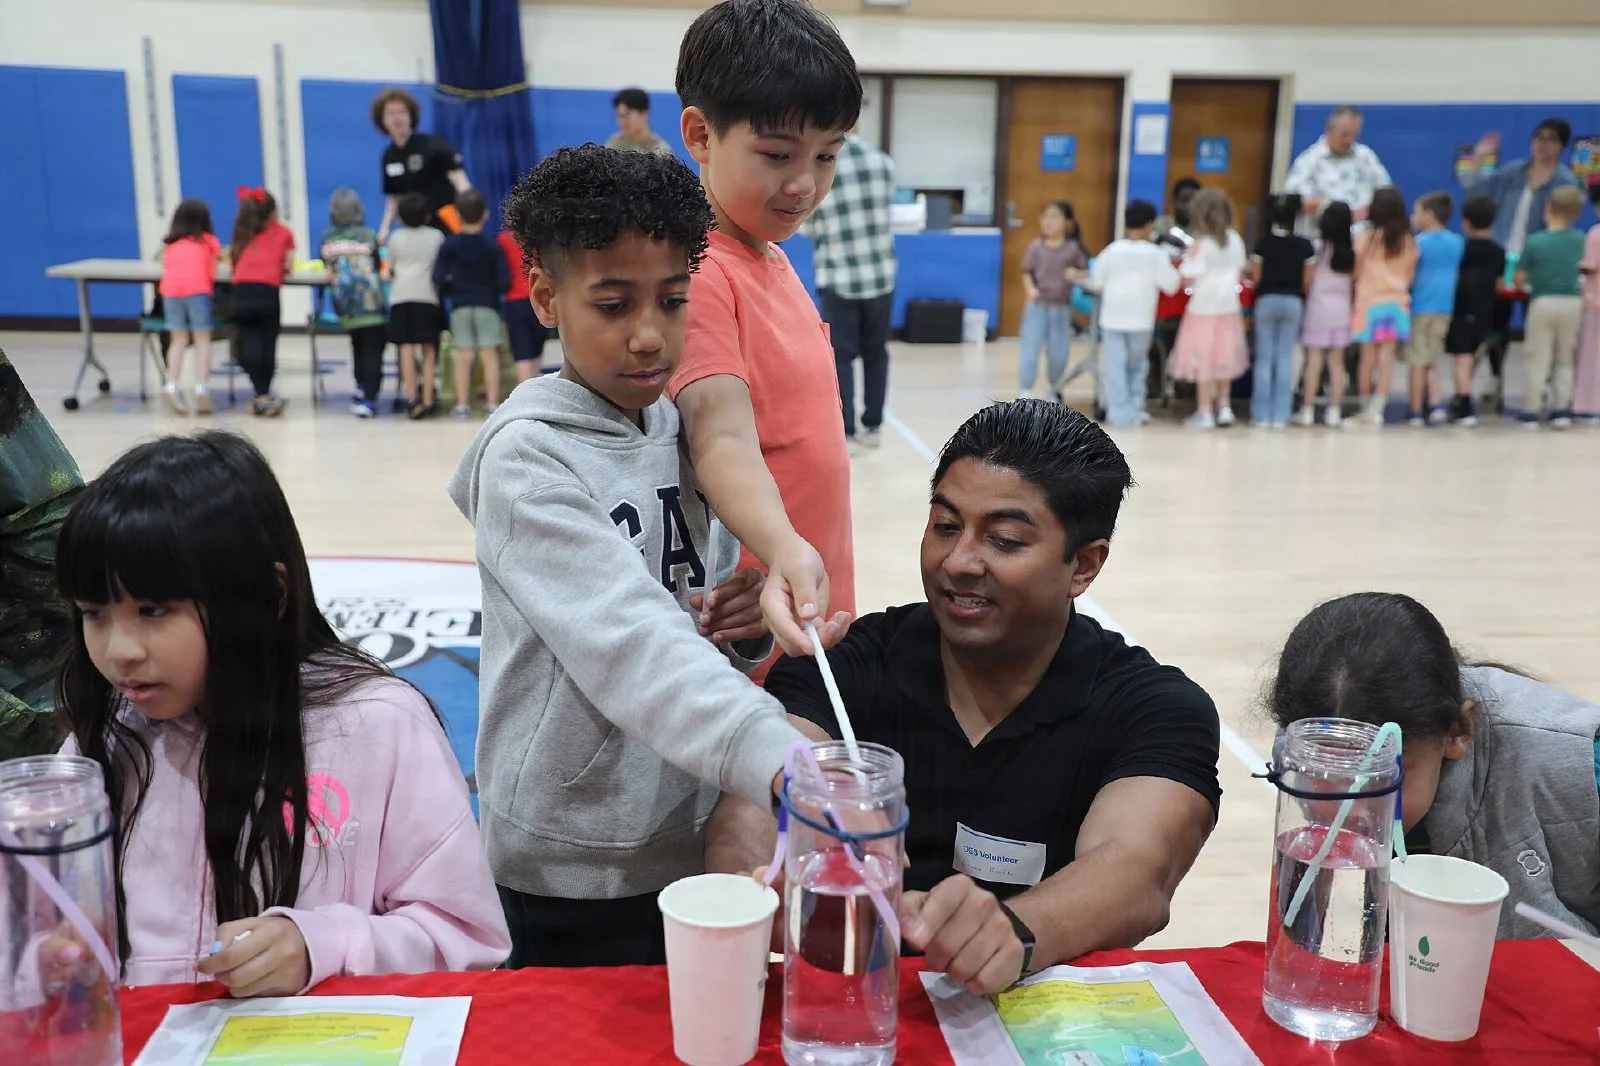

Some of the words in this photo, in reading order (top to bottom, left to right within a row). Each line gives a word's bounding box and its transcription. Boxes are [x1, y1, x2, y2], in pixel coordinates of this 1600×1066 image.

[288, 821, 359, 848] OVE
[963, 845, 978, 857] OES
[979, 850, 1020, 864] Volunteer
[1409, 961, 1436, 973] Friends
[1419, 959, 1440, 968] Good
